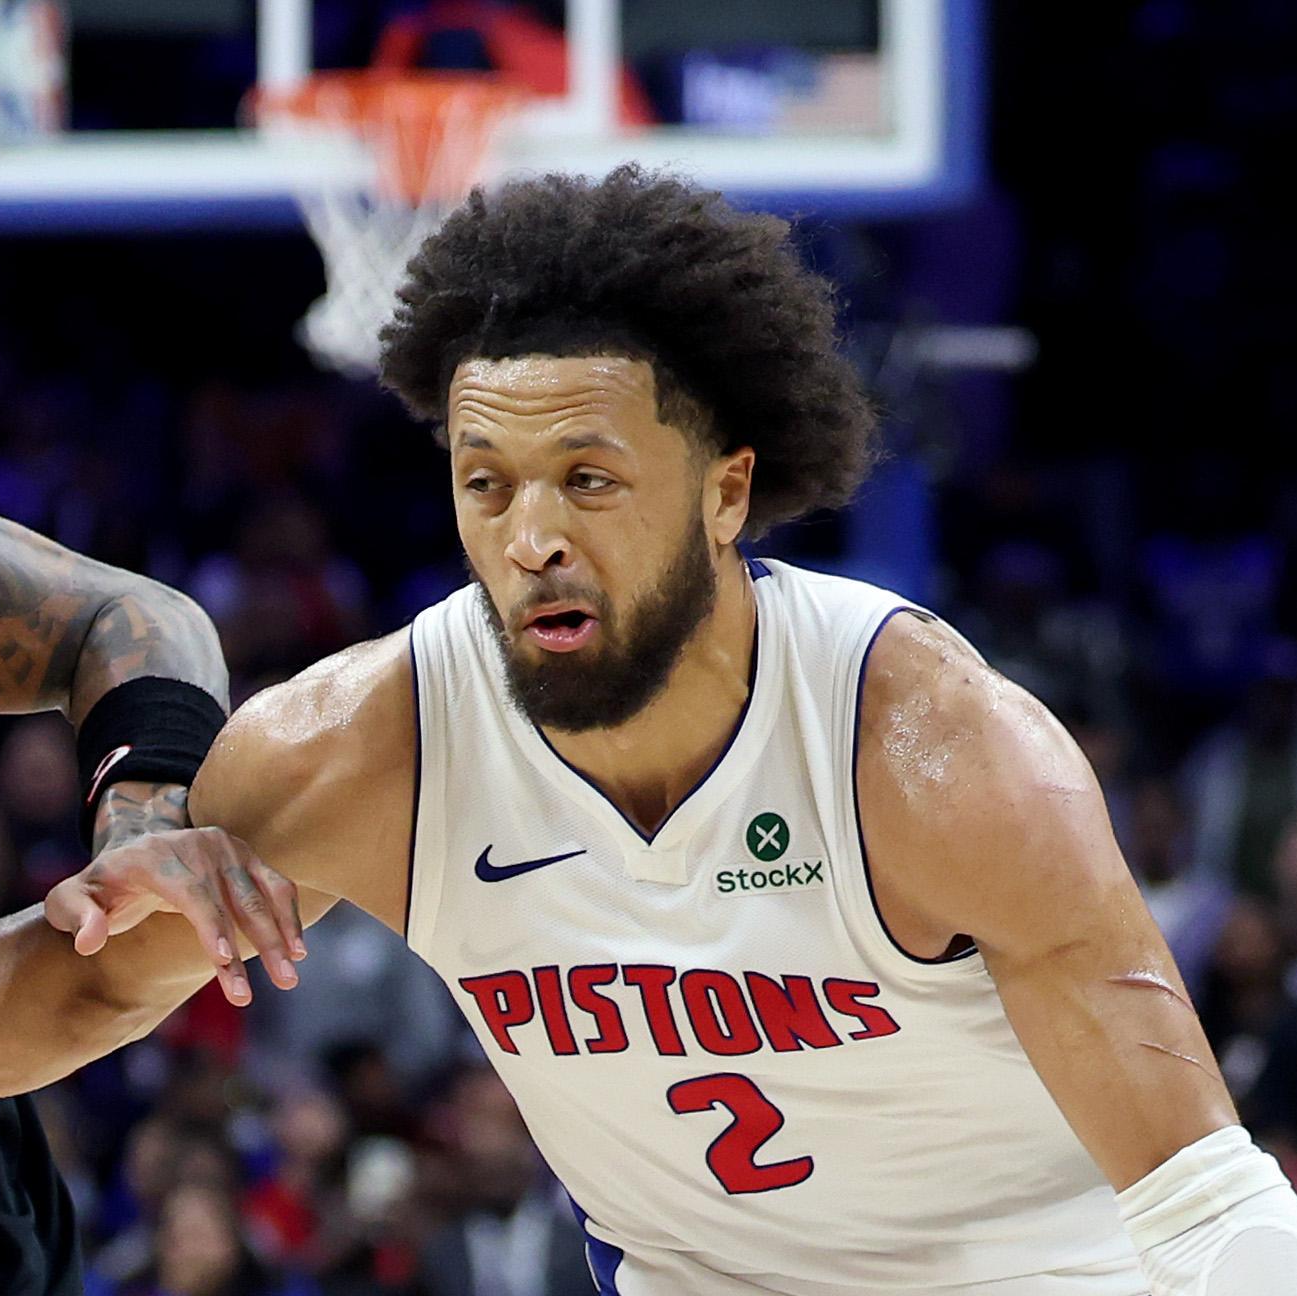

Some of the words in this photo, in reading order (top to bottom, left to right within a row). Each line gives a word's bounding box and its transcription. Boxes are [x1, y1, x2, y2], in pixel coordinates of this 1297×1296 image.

[716, 860, 824, 894] StockX
[458, 962, 901, 1057] PISTONS
[665, 1072, 815, 1195] 2
